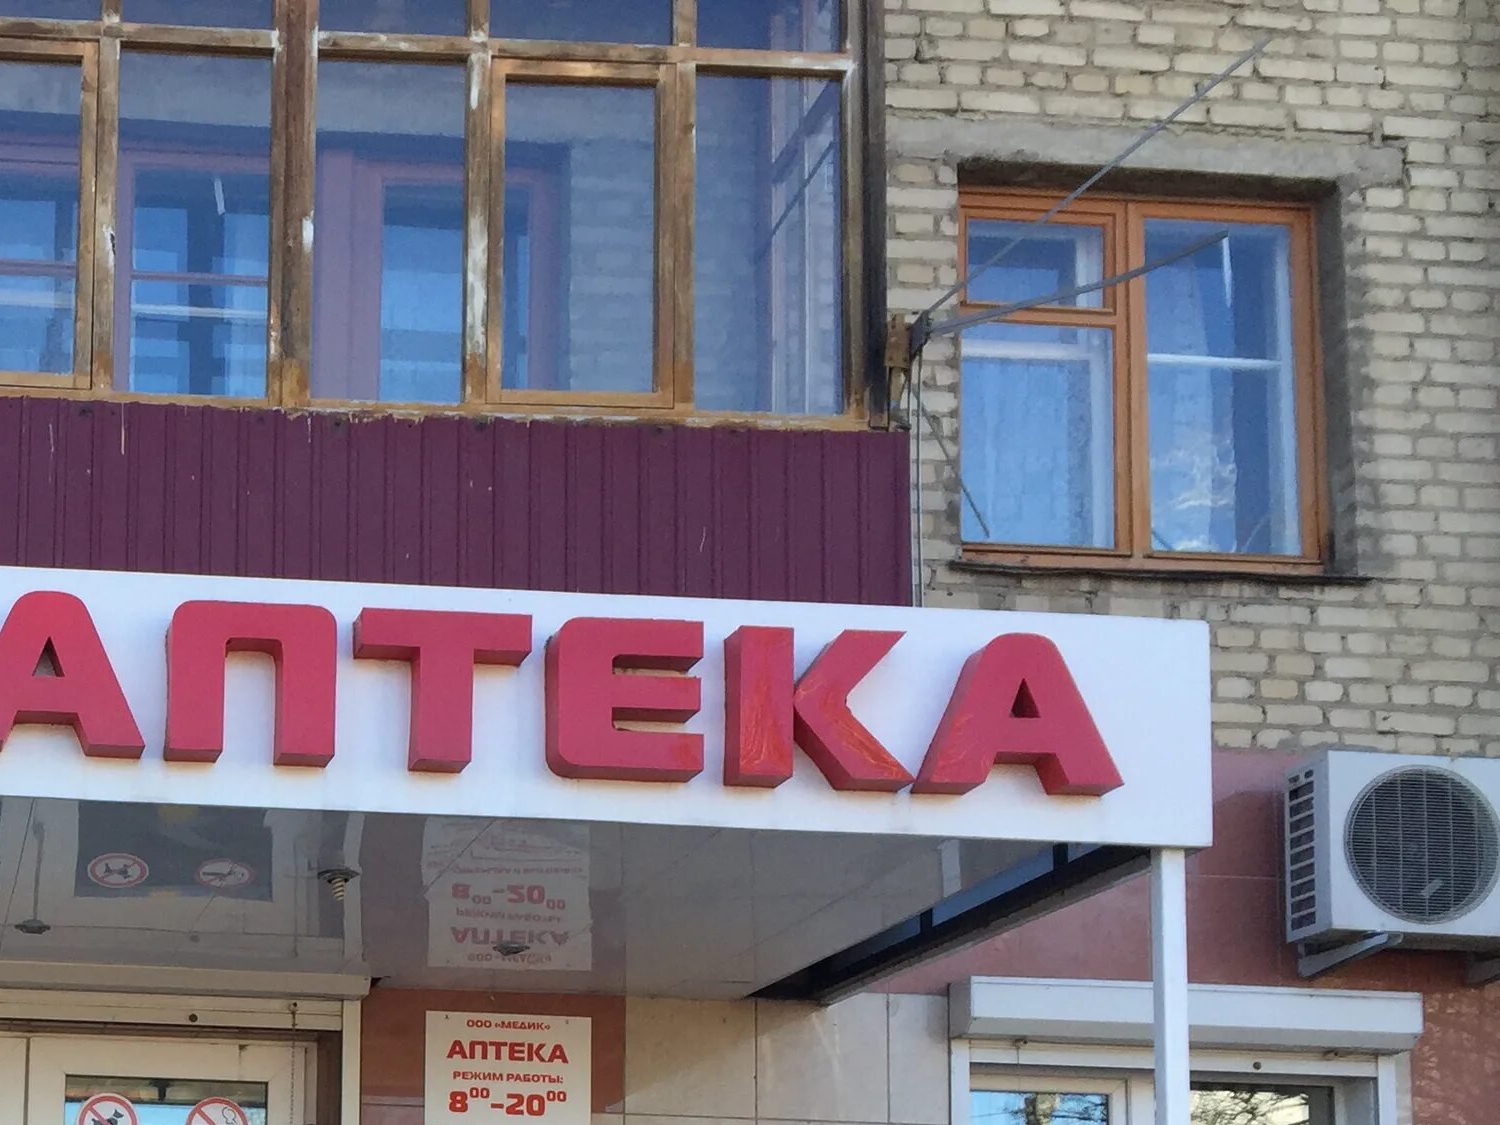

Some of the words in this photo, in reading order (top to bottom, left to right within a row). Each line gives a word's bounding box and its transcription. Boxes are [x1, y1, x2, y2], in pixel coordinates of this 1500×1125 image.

[466, 1019, 492, 1029] ООО
[446, 1039, 569, 1064] АПТЕКА
[453, 1070, 503, 1082] РЕЖИМ
[506, 1073, 564, 1084] РАБОТЫ:
